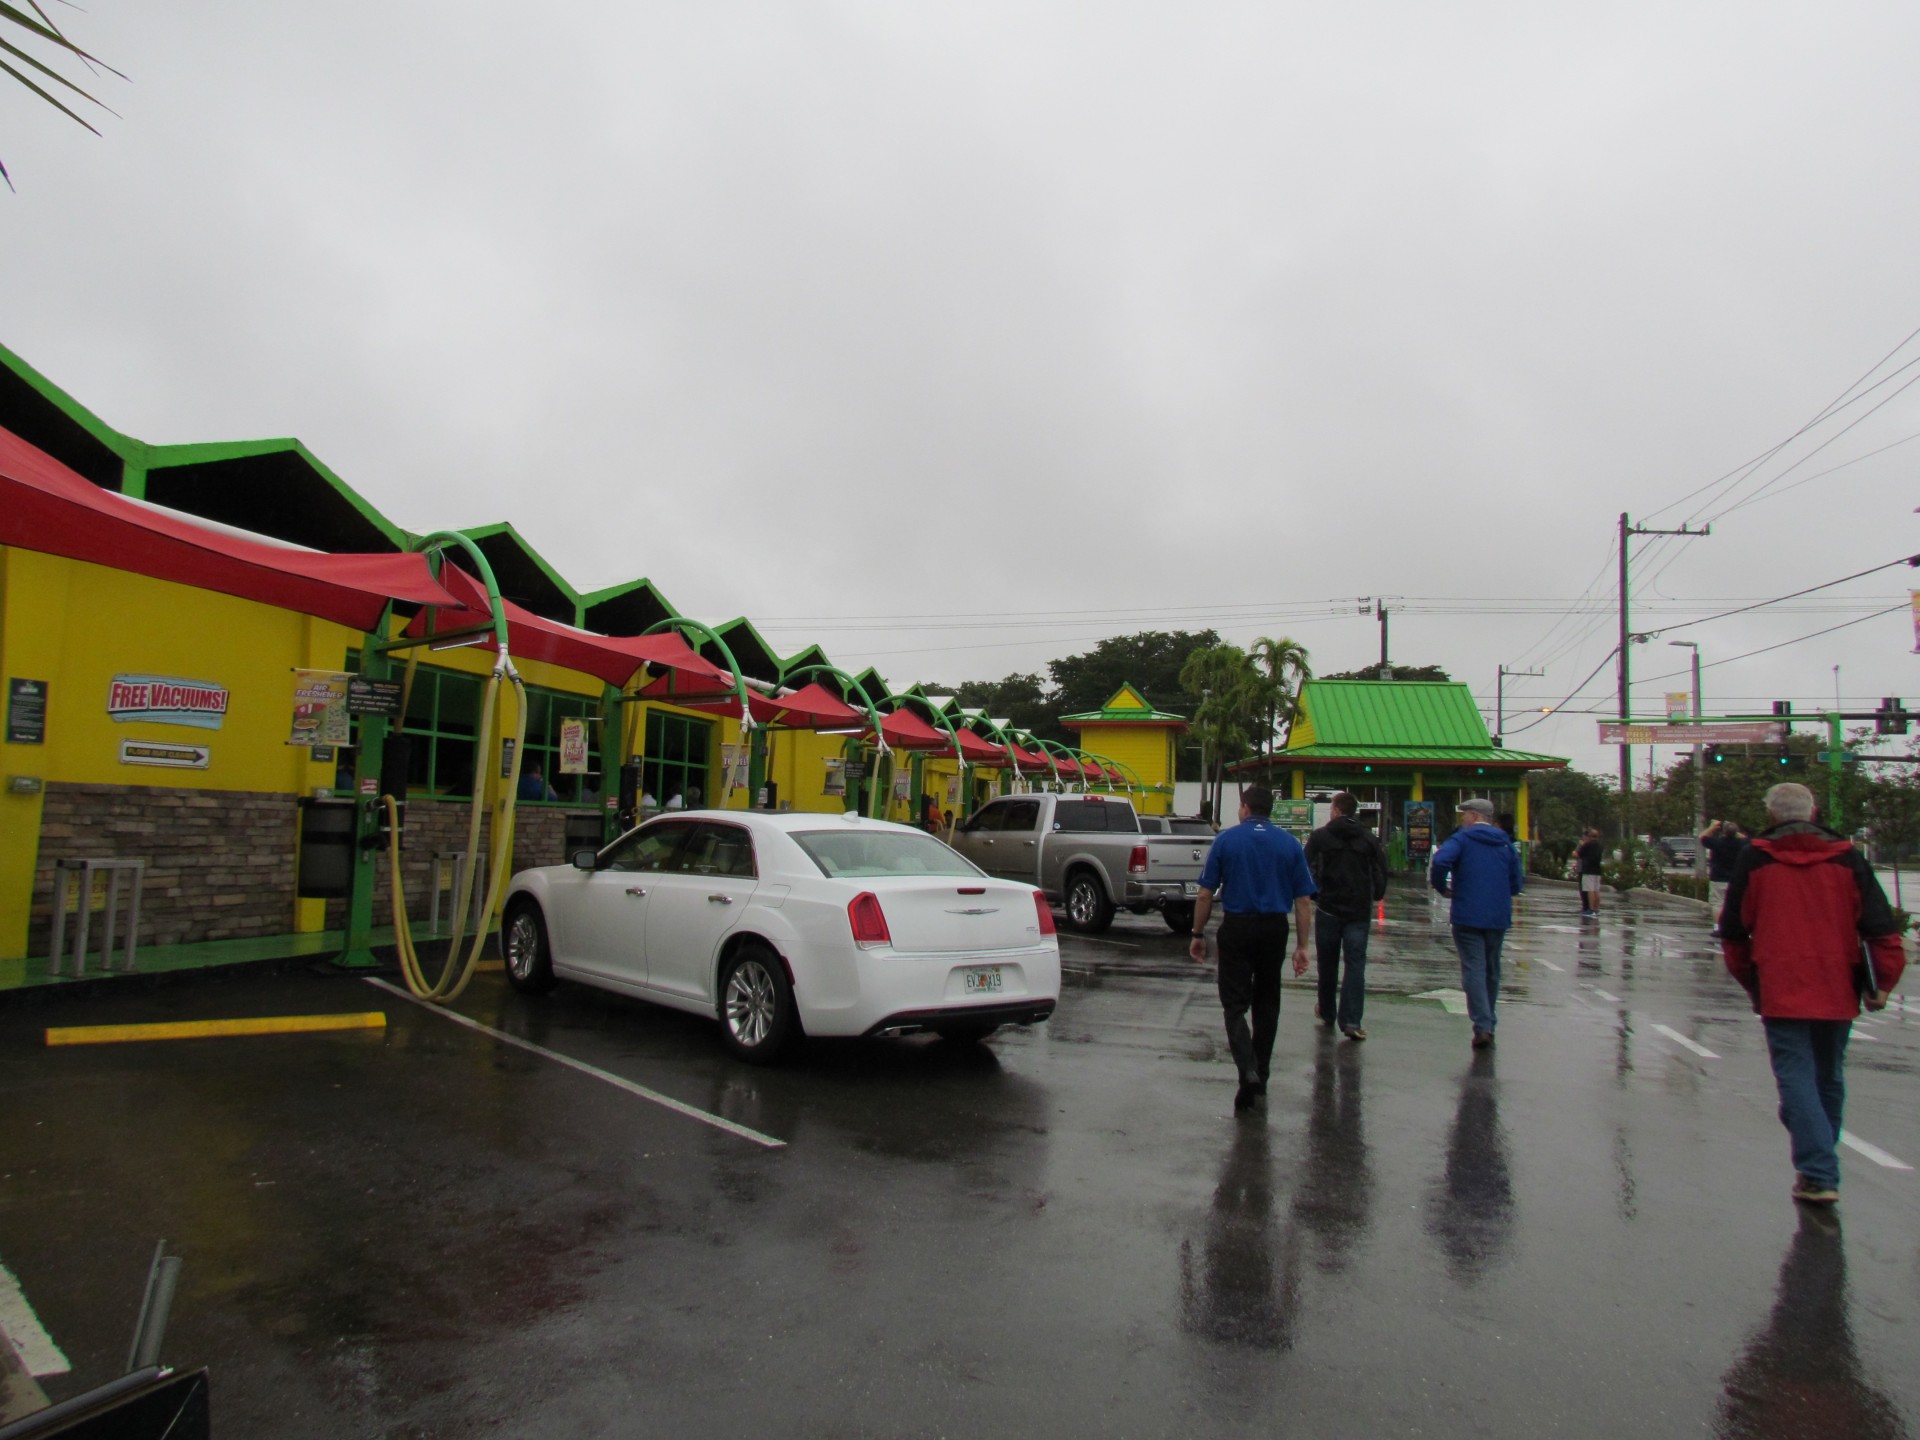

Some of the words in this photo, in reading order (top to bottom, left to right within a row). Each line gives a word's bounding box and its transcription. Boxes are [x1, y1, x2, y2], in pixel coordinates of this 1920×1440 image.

[111, 683, 148, 709] FREE
[151, 683, 226, 710] VACUUMS!
[296, 689, 343, 699] FRESHENER
[723, 757, 747, 766] TEL
